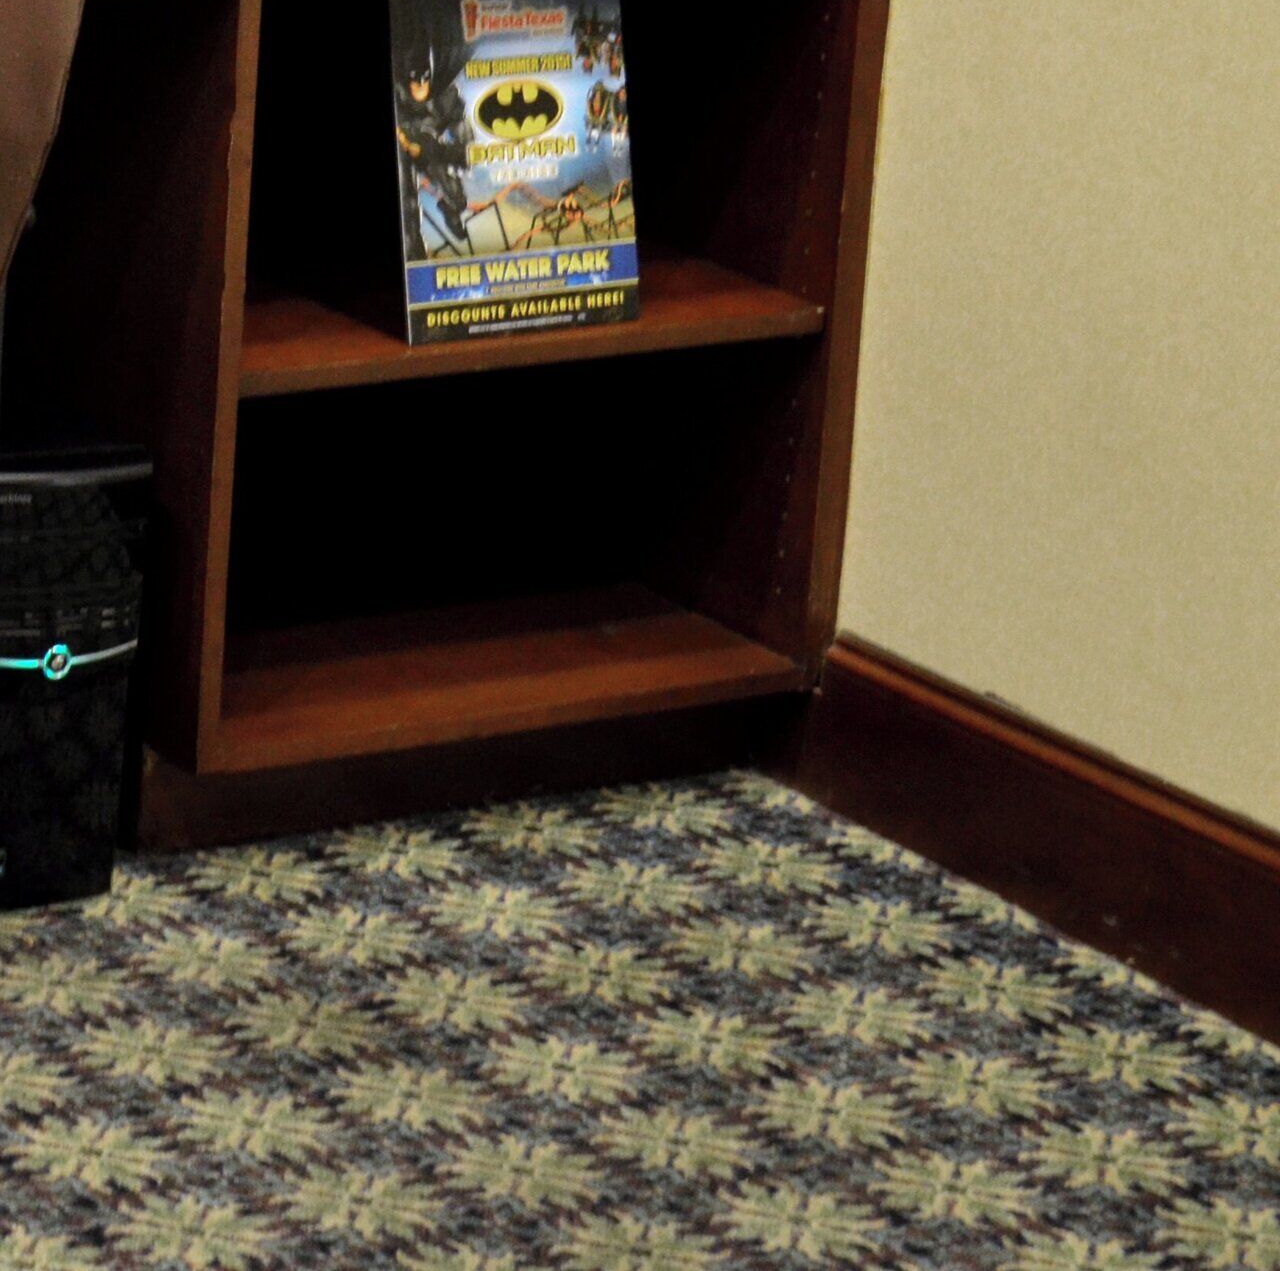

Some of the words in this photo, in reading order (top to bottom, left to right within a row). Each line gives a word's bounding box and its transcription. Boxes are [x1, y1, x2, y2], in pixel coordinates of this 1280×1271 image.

[465, 60, 491, 79] NEW
[468, 135, 576, 166] BATMAN
[435, 263, 481, 290] FREE
[485, 255, 553, 283] WATER
[556, 248, 610, 276] PARK
[426, 304, 506, 328] DISCOUNTS
[511, 295, 582, 319] AVAILABLE
[587, 290, 625, 310] HERE!
